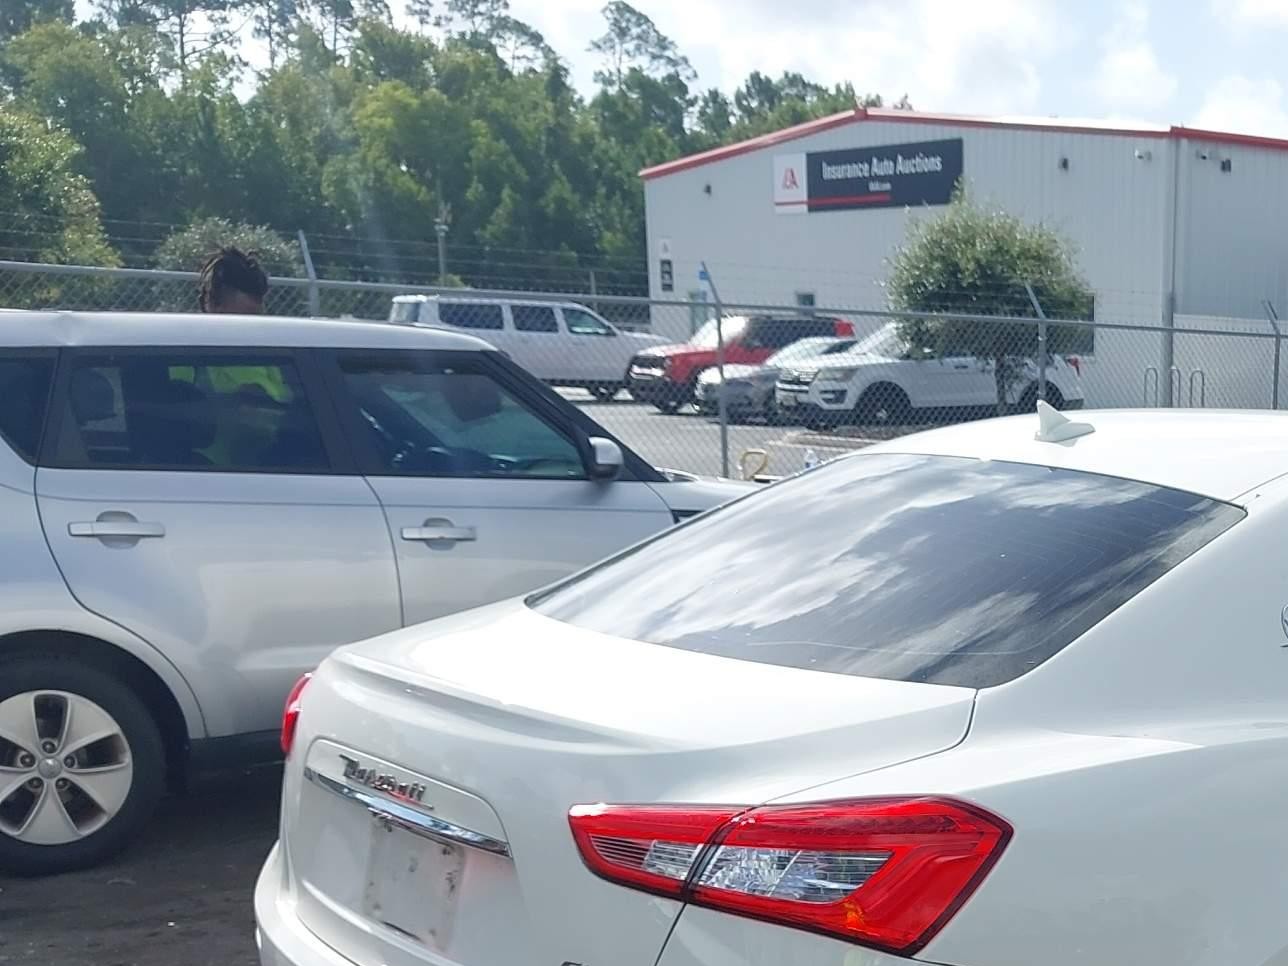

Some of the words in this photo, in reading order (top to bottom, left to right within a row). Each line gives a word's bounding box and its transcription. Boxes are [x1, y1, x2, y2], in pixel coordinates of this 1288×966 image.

[822, 161, 870, 180] Insurance
[871, 156, 895, 176] Auto
[896, 152, 942, 175] Auctions
